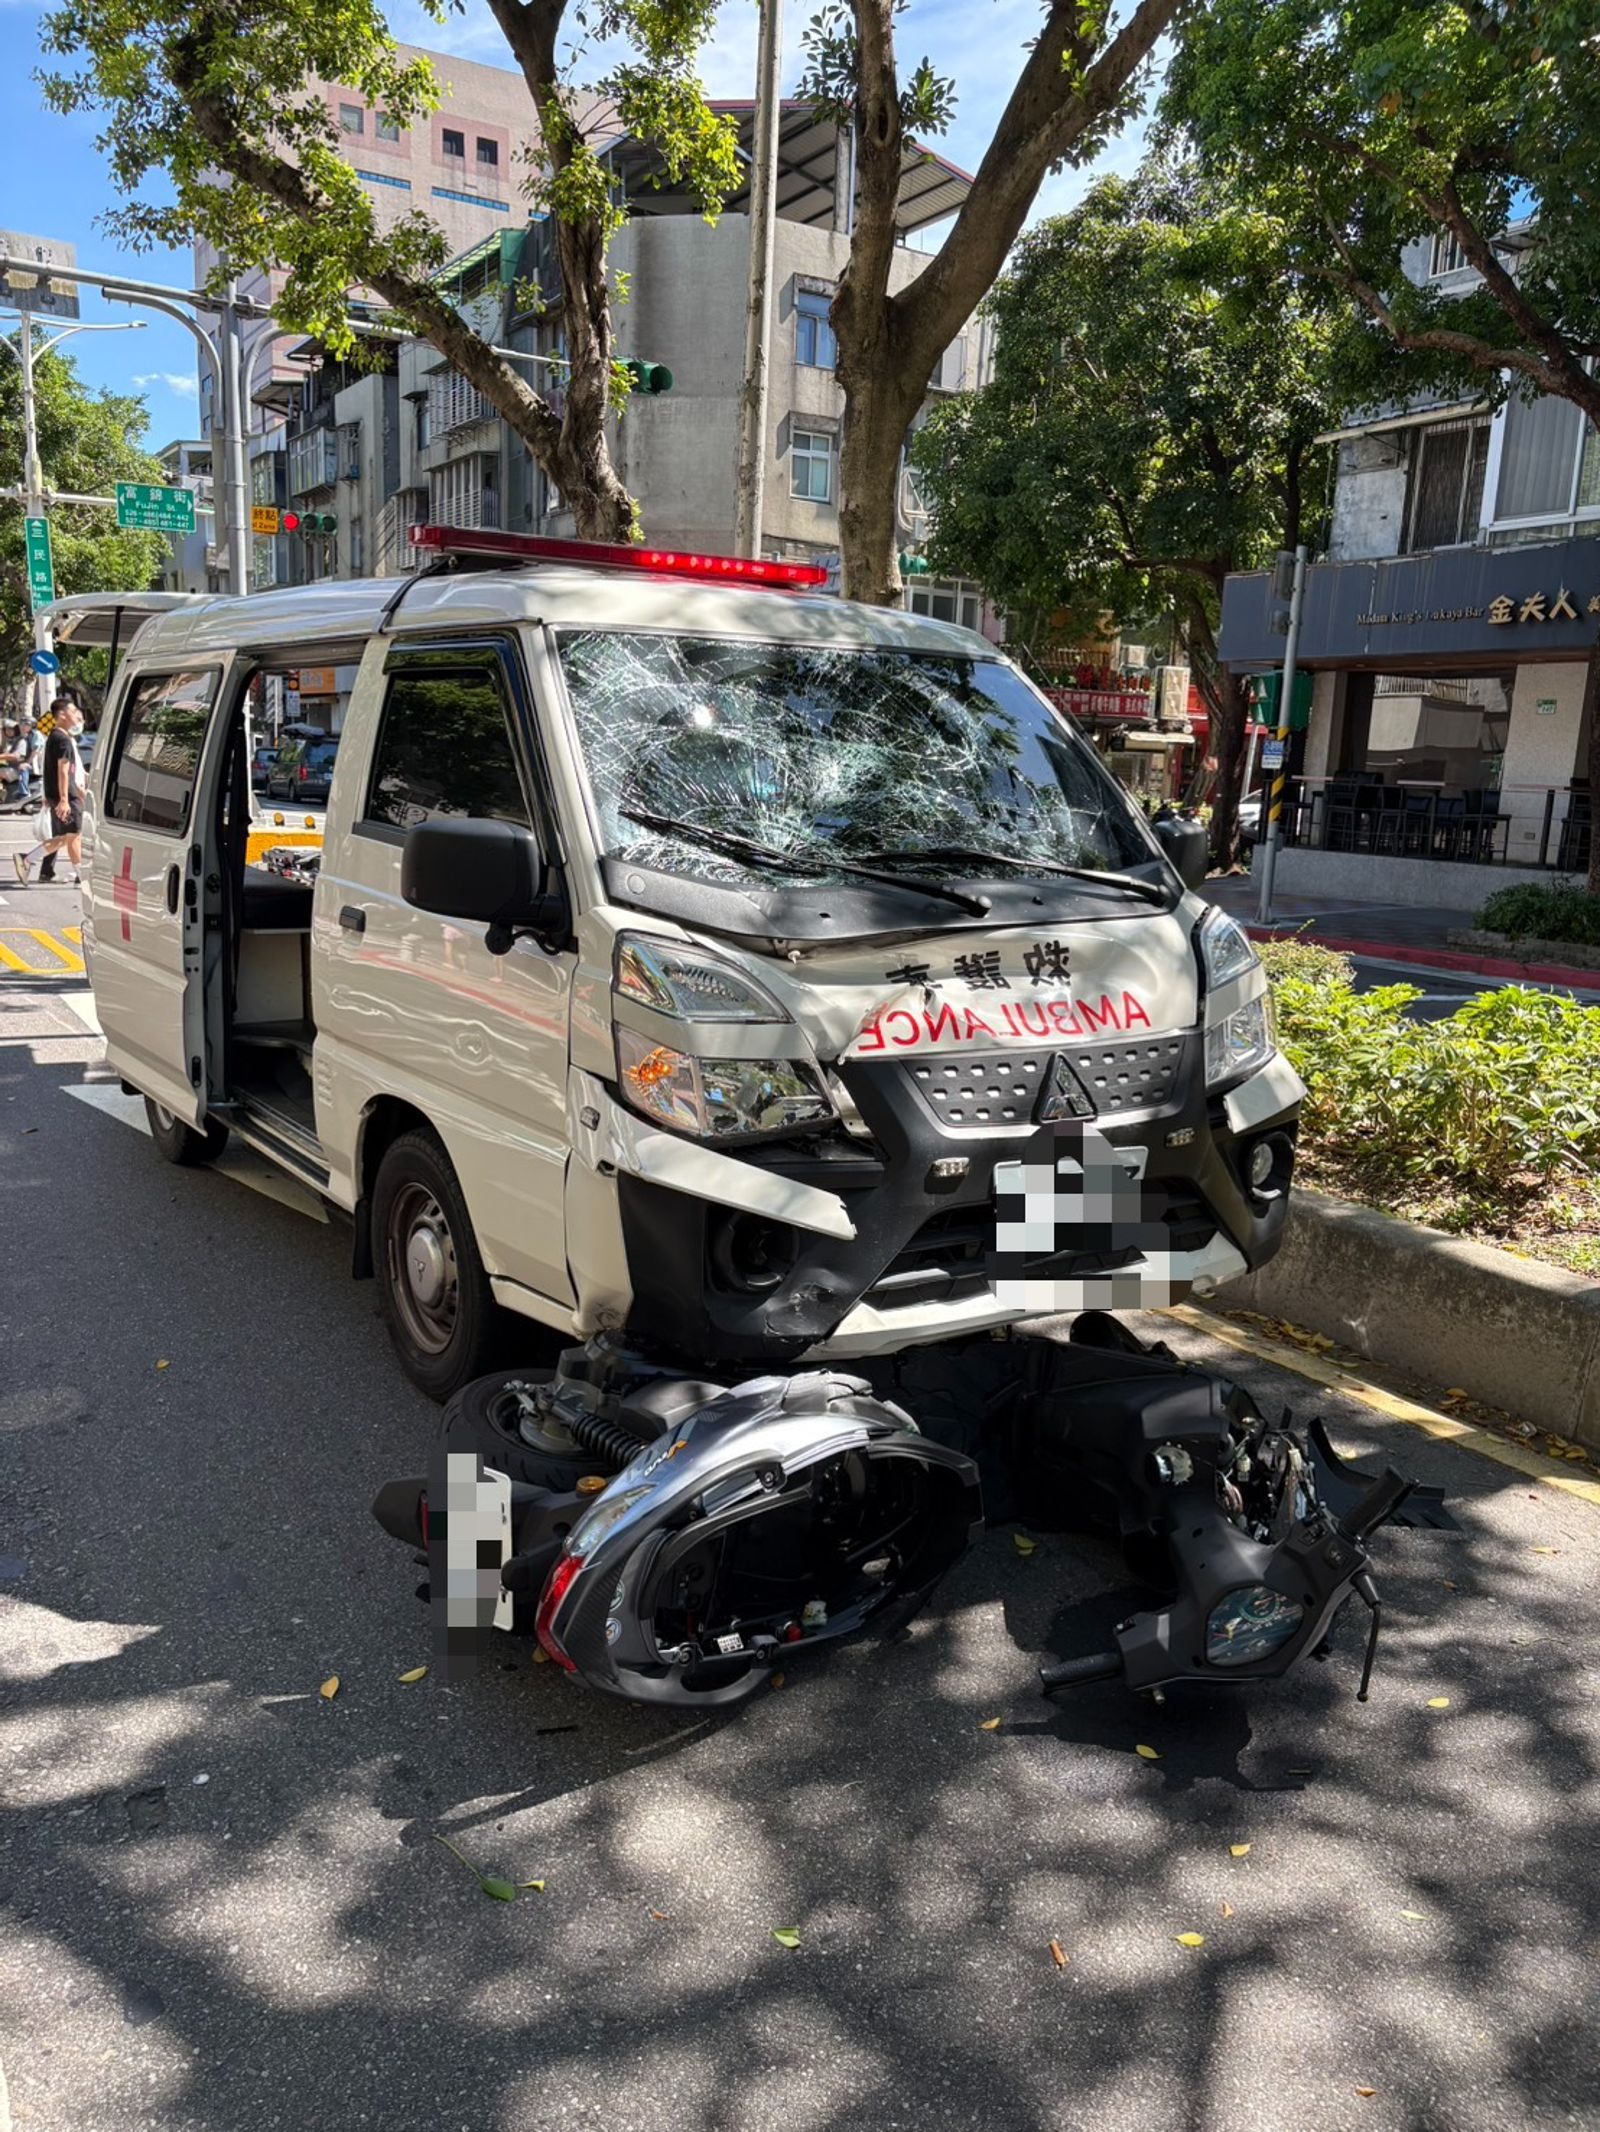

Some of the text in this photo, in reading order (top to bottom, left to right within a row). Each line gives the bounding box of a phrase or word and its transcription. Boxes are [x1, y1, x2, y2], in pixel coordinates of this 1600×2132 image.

[124, 485, 187, 504] 富錦街
[1487, 590, 1578, 625] 金夫人
